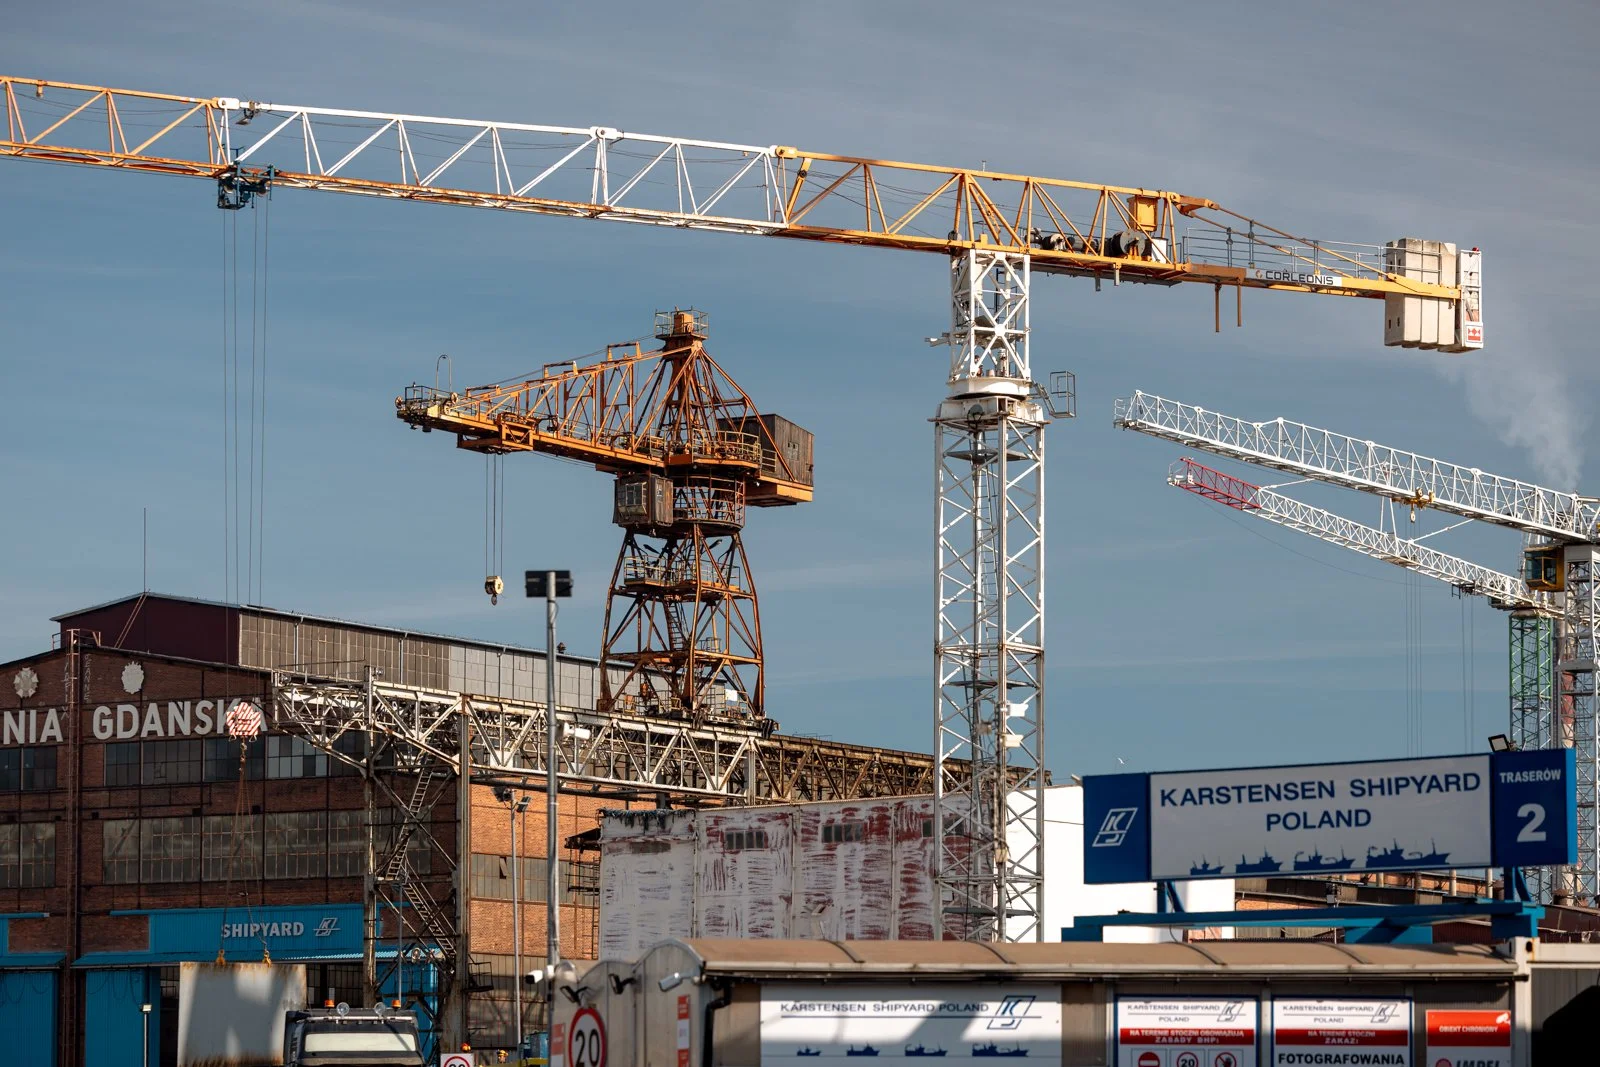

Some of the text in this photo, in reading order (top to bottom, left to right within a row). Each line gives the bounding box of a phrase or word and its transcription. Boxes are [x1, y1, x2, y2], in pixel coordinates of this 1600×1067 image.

[1265, 271, 1334, 285] CORLEONIS
[3, 708, 63, 745] NIA
[1499, 768, 1562, 784] TRASERÓW
[1160, 772, 1482, 808] KARSTENSEN SHIPYARD
[1266, 808, 1372, 832] POLAND
[1516, 803, 1548, 843] 2
[222, 921, 304, 938] SHIPYARD
[780, 1003, 989, 1012] KARSTENSEN SHIPYARD POLAND
[575, 1028, 600, 1067] 20
[1180, 1058, 1195, 1067] 20
[1278, 1053, 1405, 1065] FOTOGRAFOWANIA
